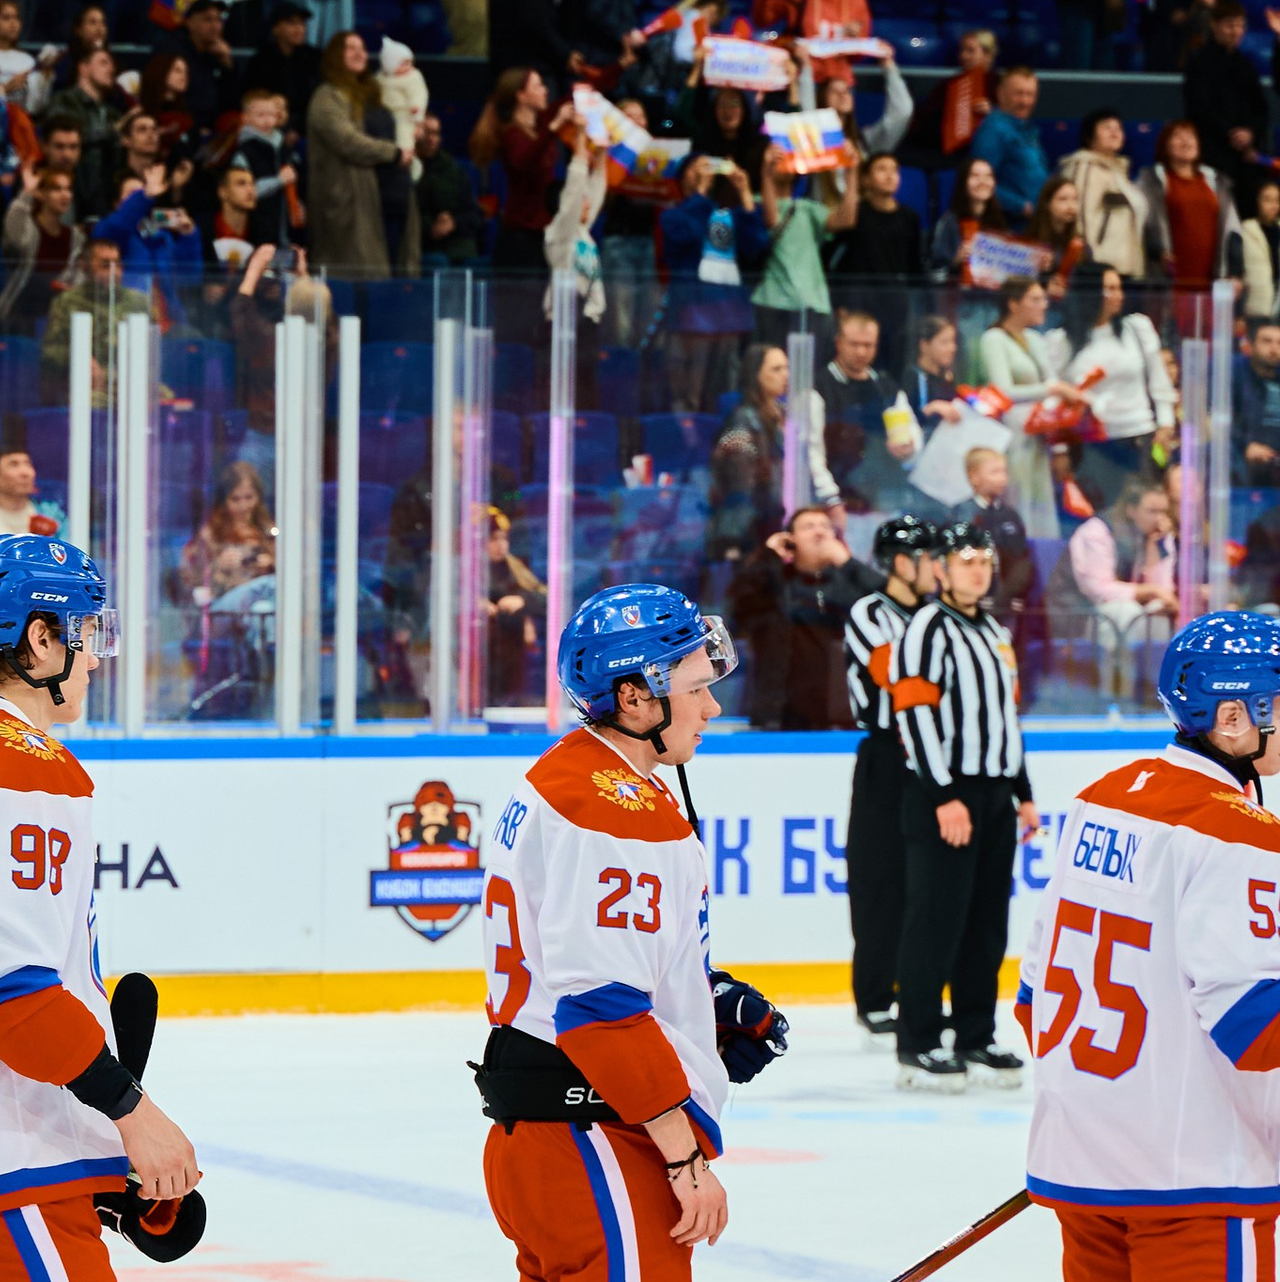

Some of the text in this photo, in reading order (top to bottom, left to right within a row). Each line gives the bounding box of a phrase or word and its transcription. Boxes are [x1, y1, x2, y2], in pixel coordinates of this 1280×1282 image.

[30, 591, 69, 604] CCM
[608, 655, 645, 668] CCM
[1212, 681, 1251, 691] CCM
[10, 823, 72, 896] 98
[1073, 820, 1143, 884] БЕЛЫХ
[596, 867, 663, 934] 23
[1248, 878, 1280, 940] 5
[486, 874, 532, 1029] 3
[1038, 898, 1153, 1082] 55
